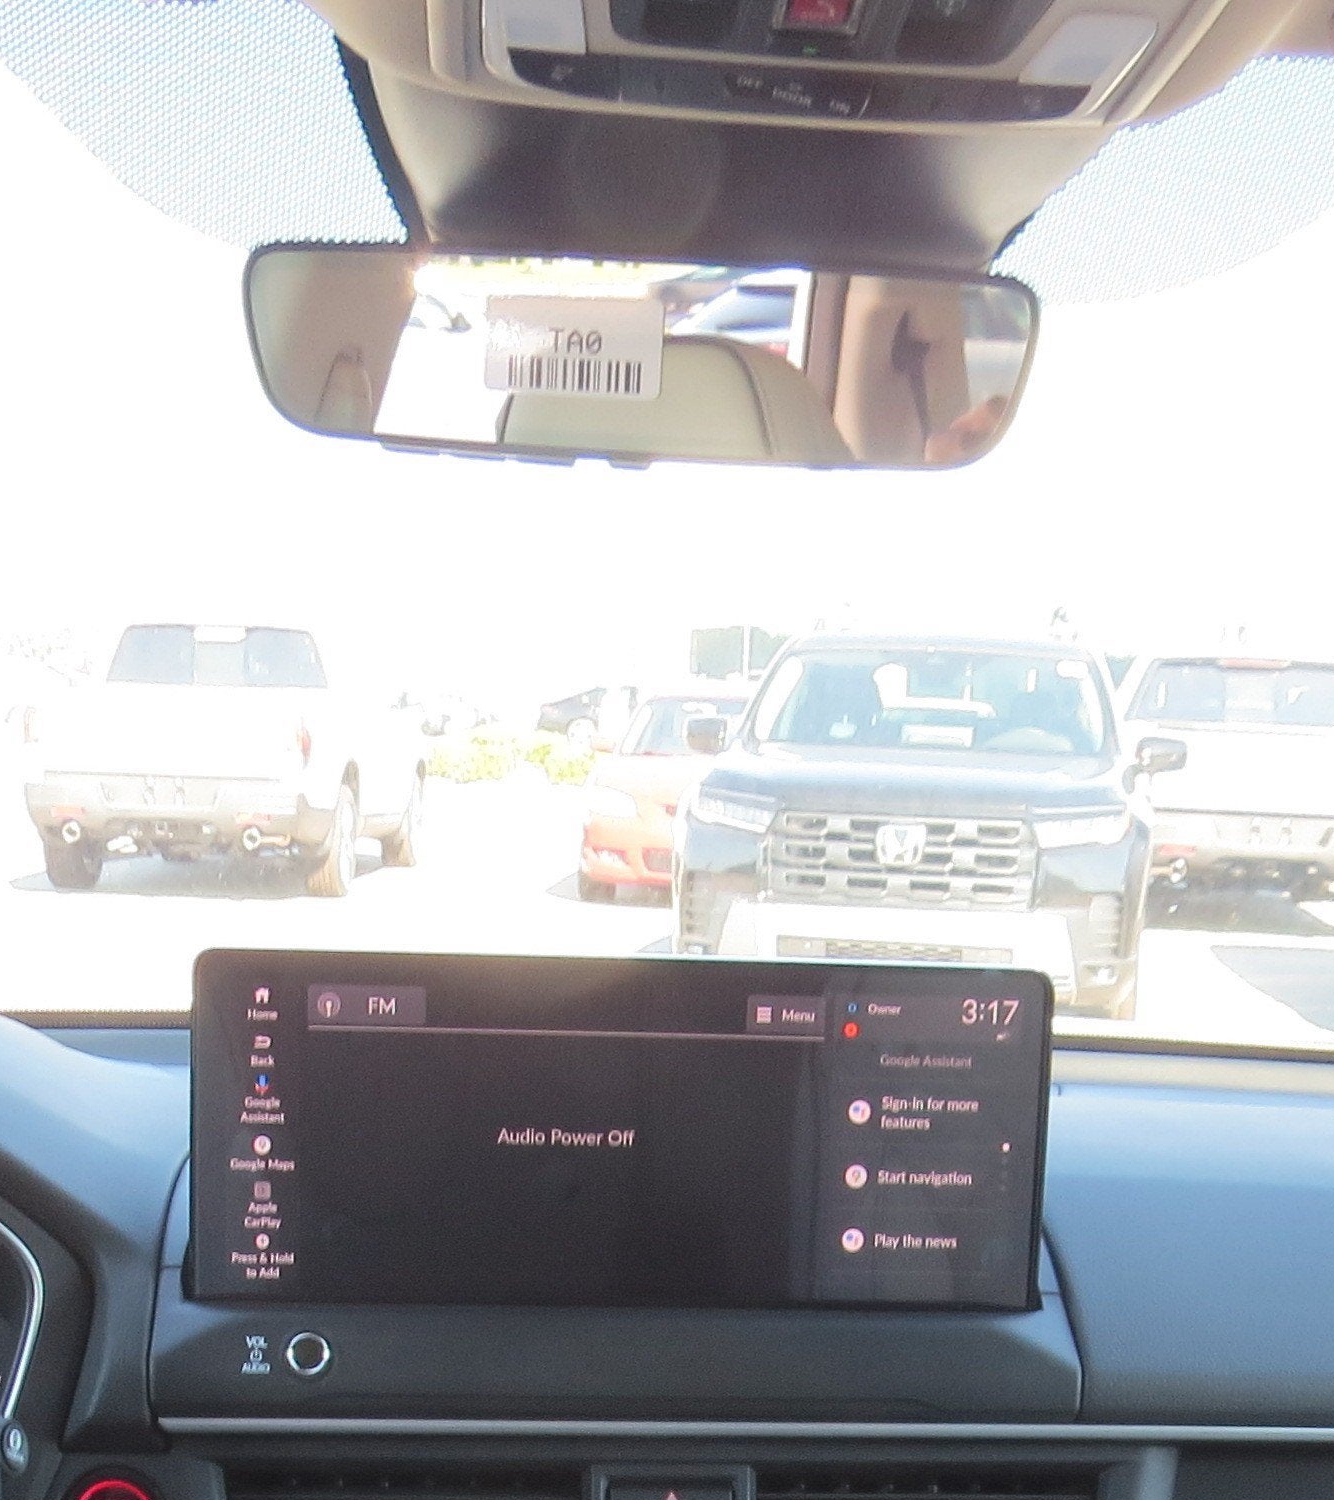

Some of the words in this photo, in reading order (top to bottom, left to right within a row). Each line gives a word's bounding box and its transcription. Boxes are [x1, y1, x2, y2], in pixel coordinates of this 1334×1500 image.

[368, 997, 396, 1016] FM
[868, 1003, 901, 1015] Owner
[961, 999, 1019, 1026] 3:17
[247, 1008, 278, 1020] Home
[781, 1008, 815, 1022] Menu
[250, 1055, 275, 1067] Back
[880, 1054, 919, 1069] Google
[922, 1055, 972, 1069] Assistant
[244, 1096, 281, 1109] Google
[882, 1096, 923, 1112] Sign-in
[927, 1097, 944, 1109] for
[947, 1100, 979, 1112] more
[240, 1111, 285, 1123] Assistant
[881, 1115, 930, 1129] features
[497, 1128, 545, 1145] Audio
[551, 1129, 602, 1146] Power
[608, 1130, 635, 1147] Off
[230, 1158, 266, 1171] Google
[268, 1159, 295, 1171] Maps
[878, 1170, 906, 1185] Start
[909, 1171, 972, 1187] navigation
[248, 1202, 278, 1214] Apple
[244, 1217, 282, 1229] CarPlay
[875, 1233, 900, 1249] Play
[903, 1234, 923, 1247] the
[926, 1237, 957, 1248] news
[231, 1252, 257, 1264] Press
[259, 1253, 268, 1264] &
[270, 1252, 295, 1265] Hold
[246, 1268, 257, 1279] to
[259, 1268, 280, 1279] Add
[245, 1335, 268, 1349] VOL
[241, 1362, 271, 1375] AUDIO
